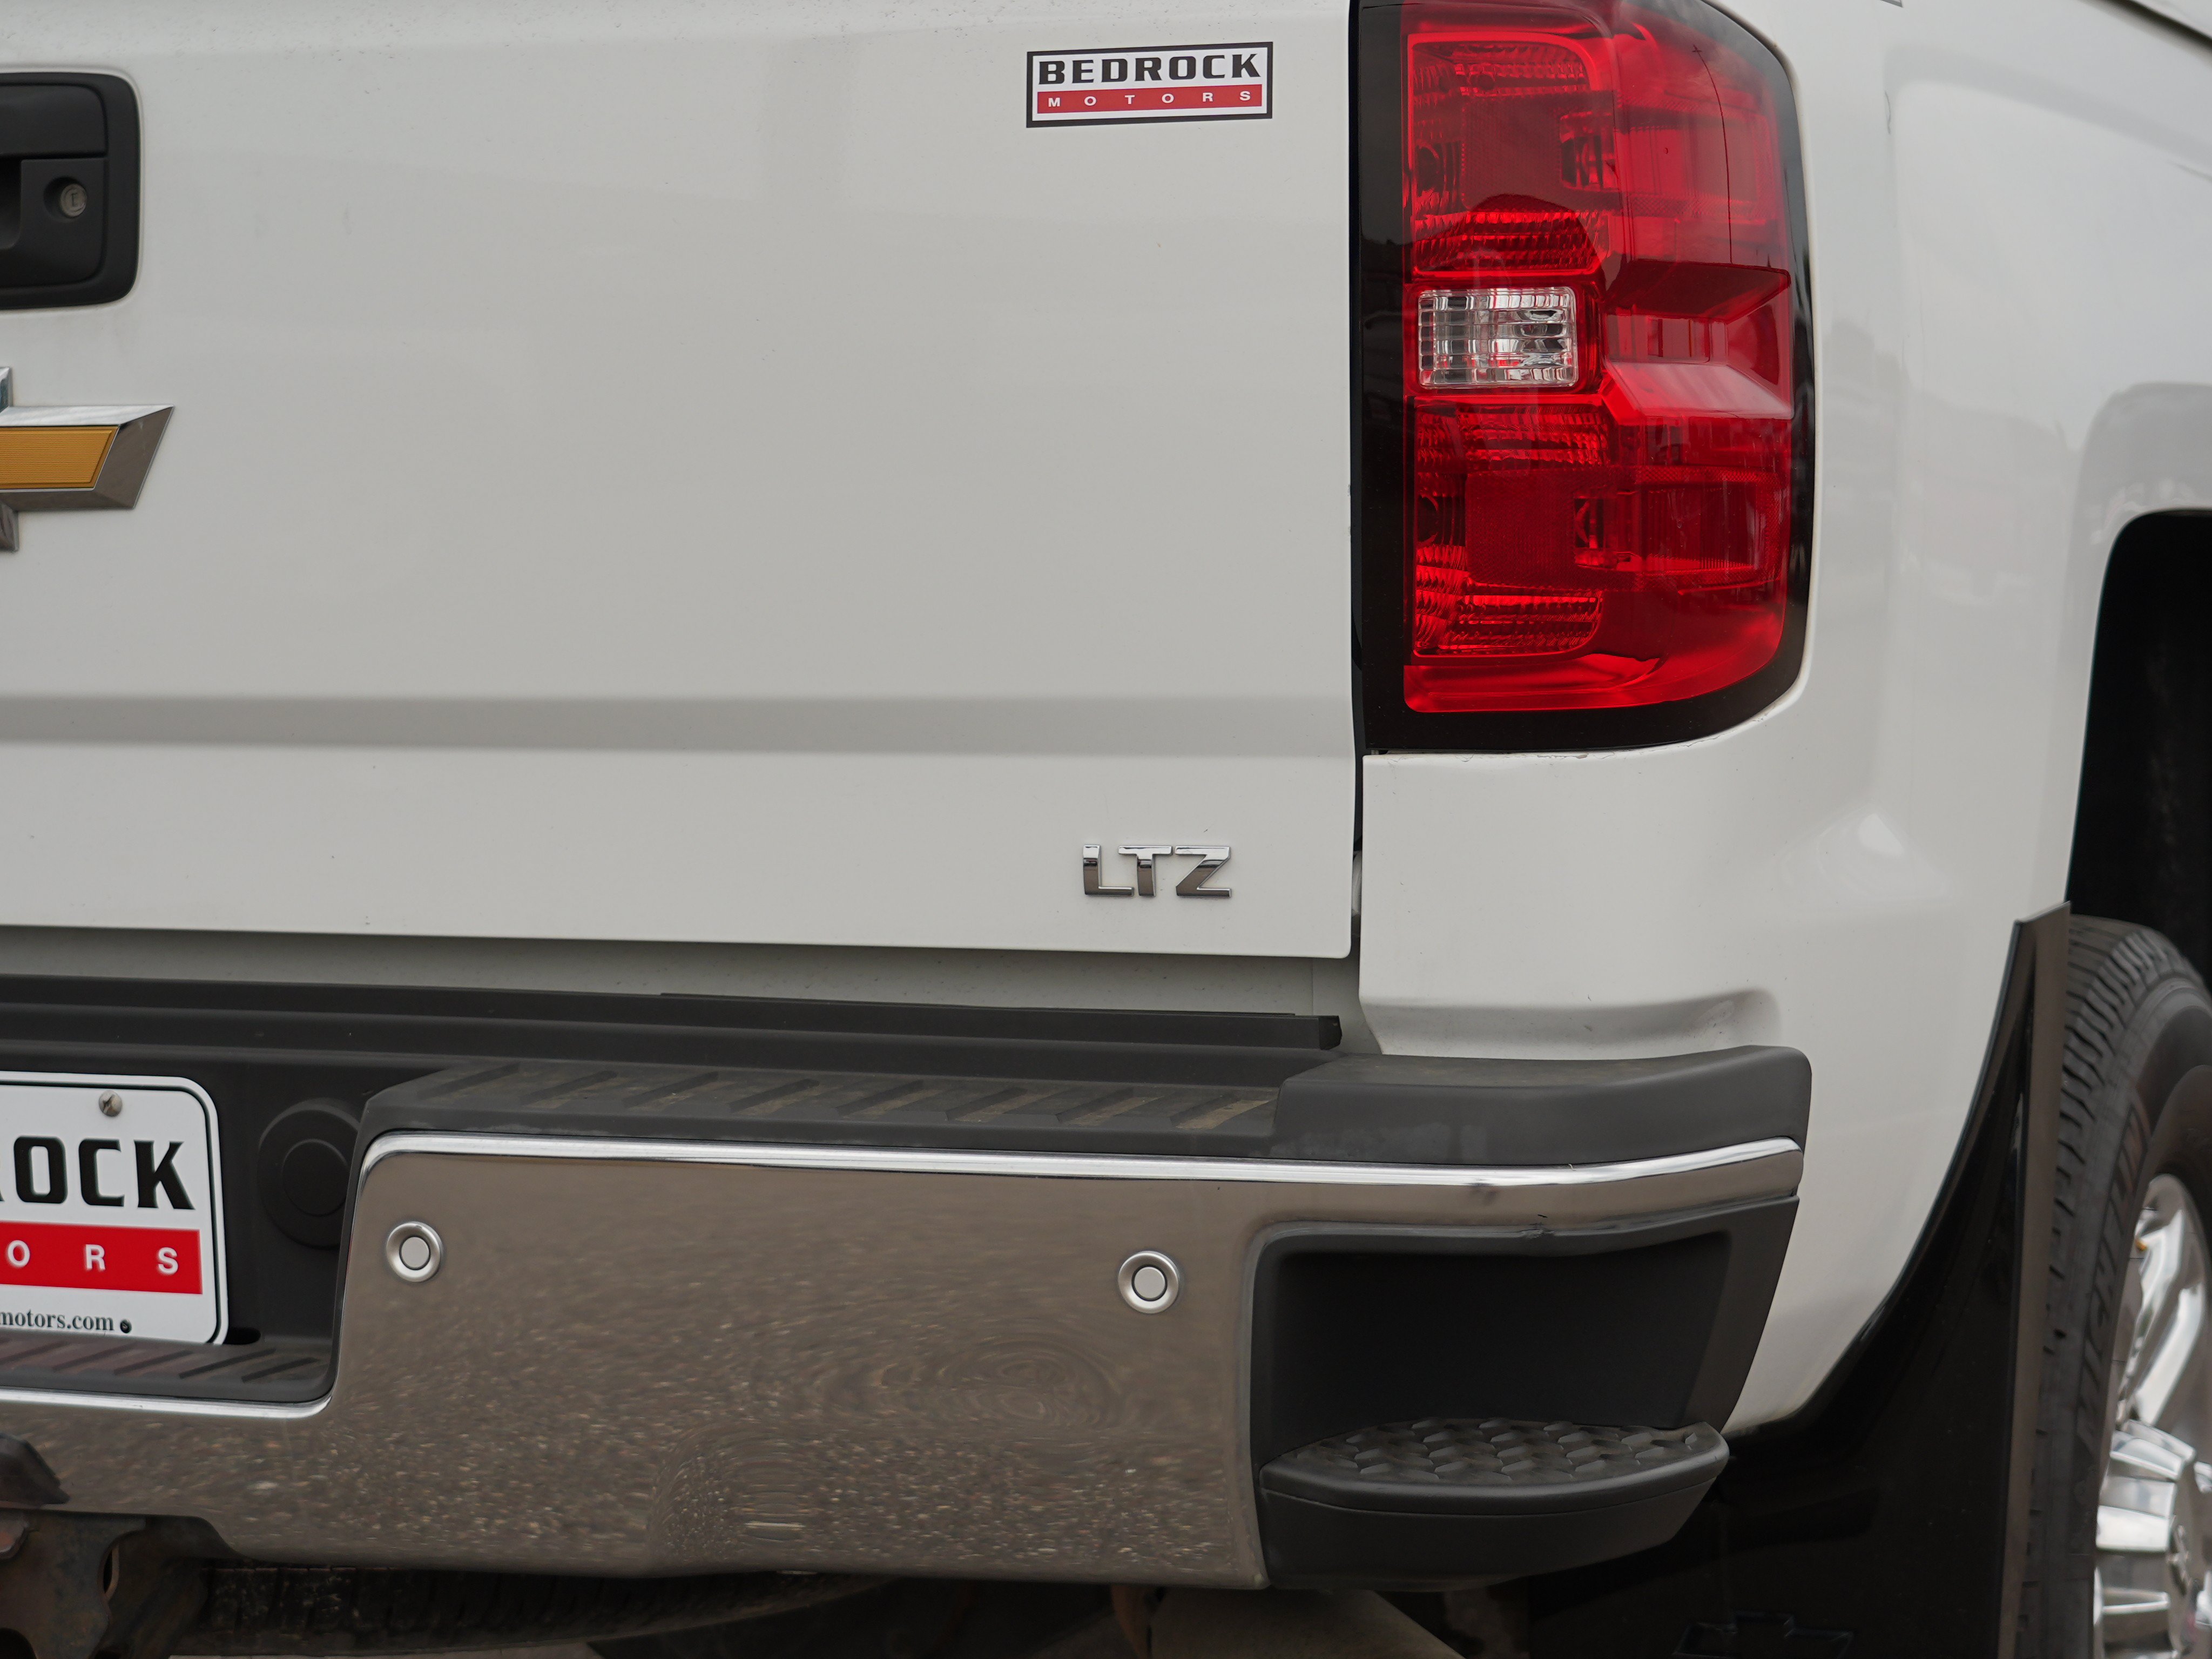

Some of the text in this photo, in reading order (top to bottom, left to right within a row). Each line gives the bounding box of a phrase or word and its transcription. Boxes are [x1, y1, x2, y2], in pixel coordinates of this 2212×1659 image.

[1038, 53, 1261, 85] BEDROCK
[1048, 91, 1251, 107] MOTORS
[1082, 845, 1232, 898] LTZ
[0, 1136, 196, 1210] OCK
[2075, 1101, 2148, 1458] MICHELIN
[0, 1309, 114, 1331] motors.com
